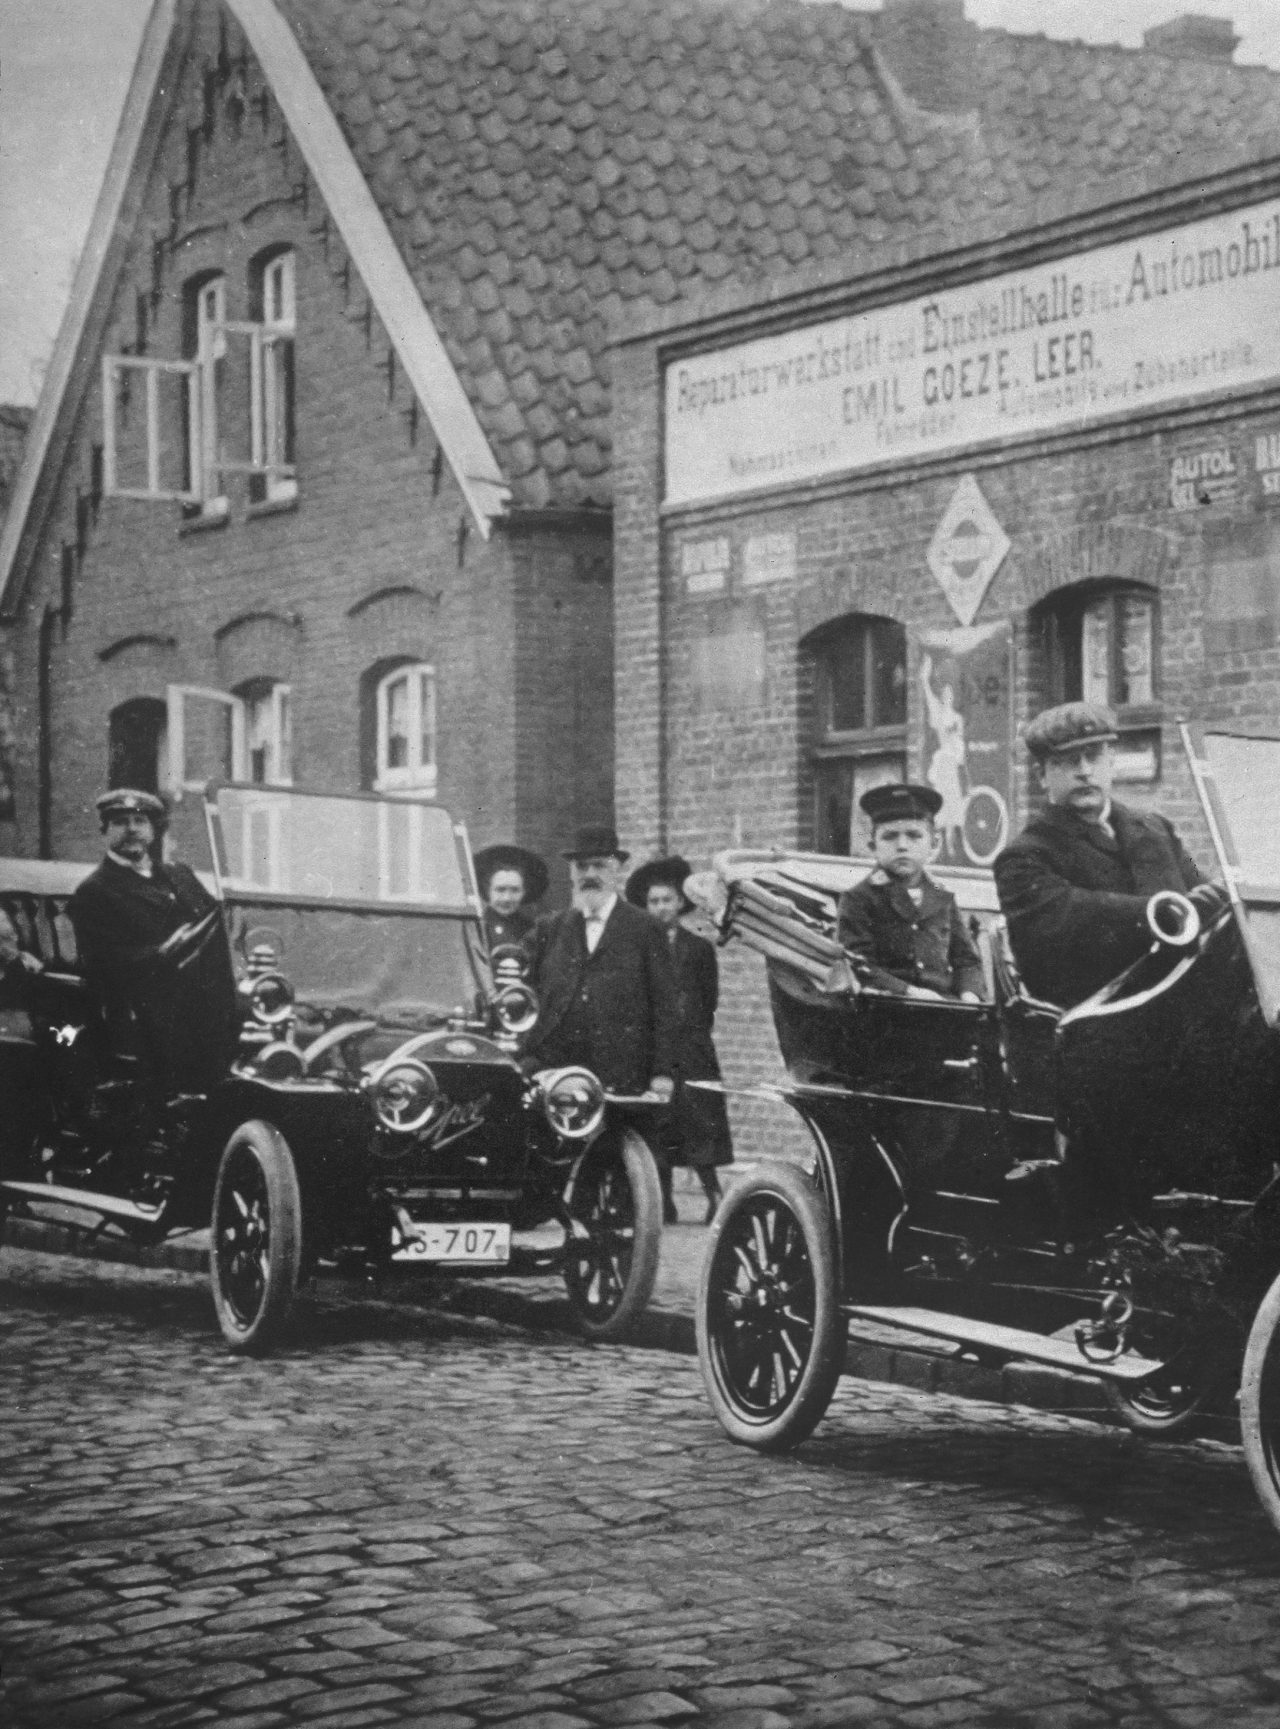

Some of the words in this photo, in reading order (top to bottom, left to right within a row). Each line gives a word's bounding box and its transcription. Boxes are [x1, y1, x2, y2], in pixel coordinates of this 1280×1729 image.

[922, 273, 1083, 354] Einstellhalle
[842, 376, 904, 425] EMIL
[1171, 450, 1235, 480] AUTOL
[404, 1228, 497, 1255] S-707
